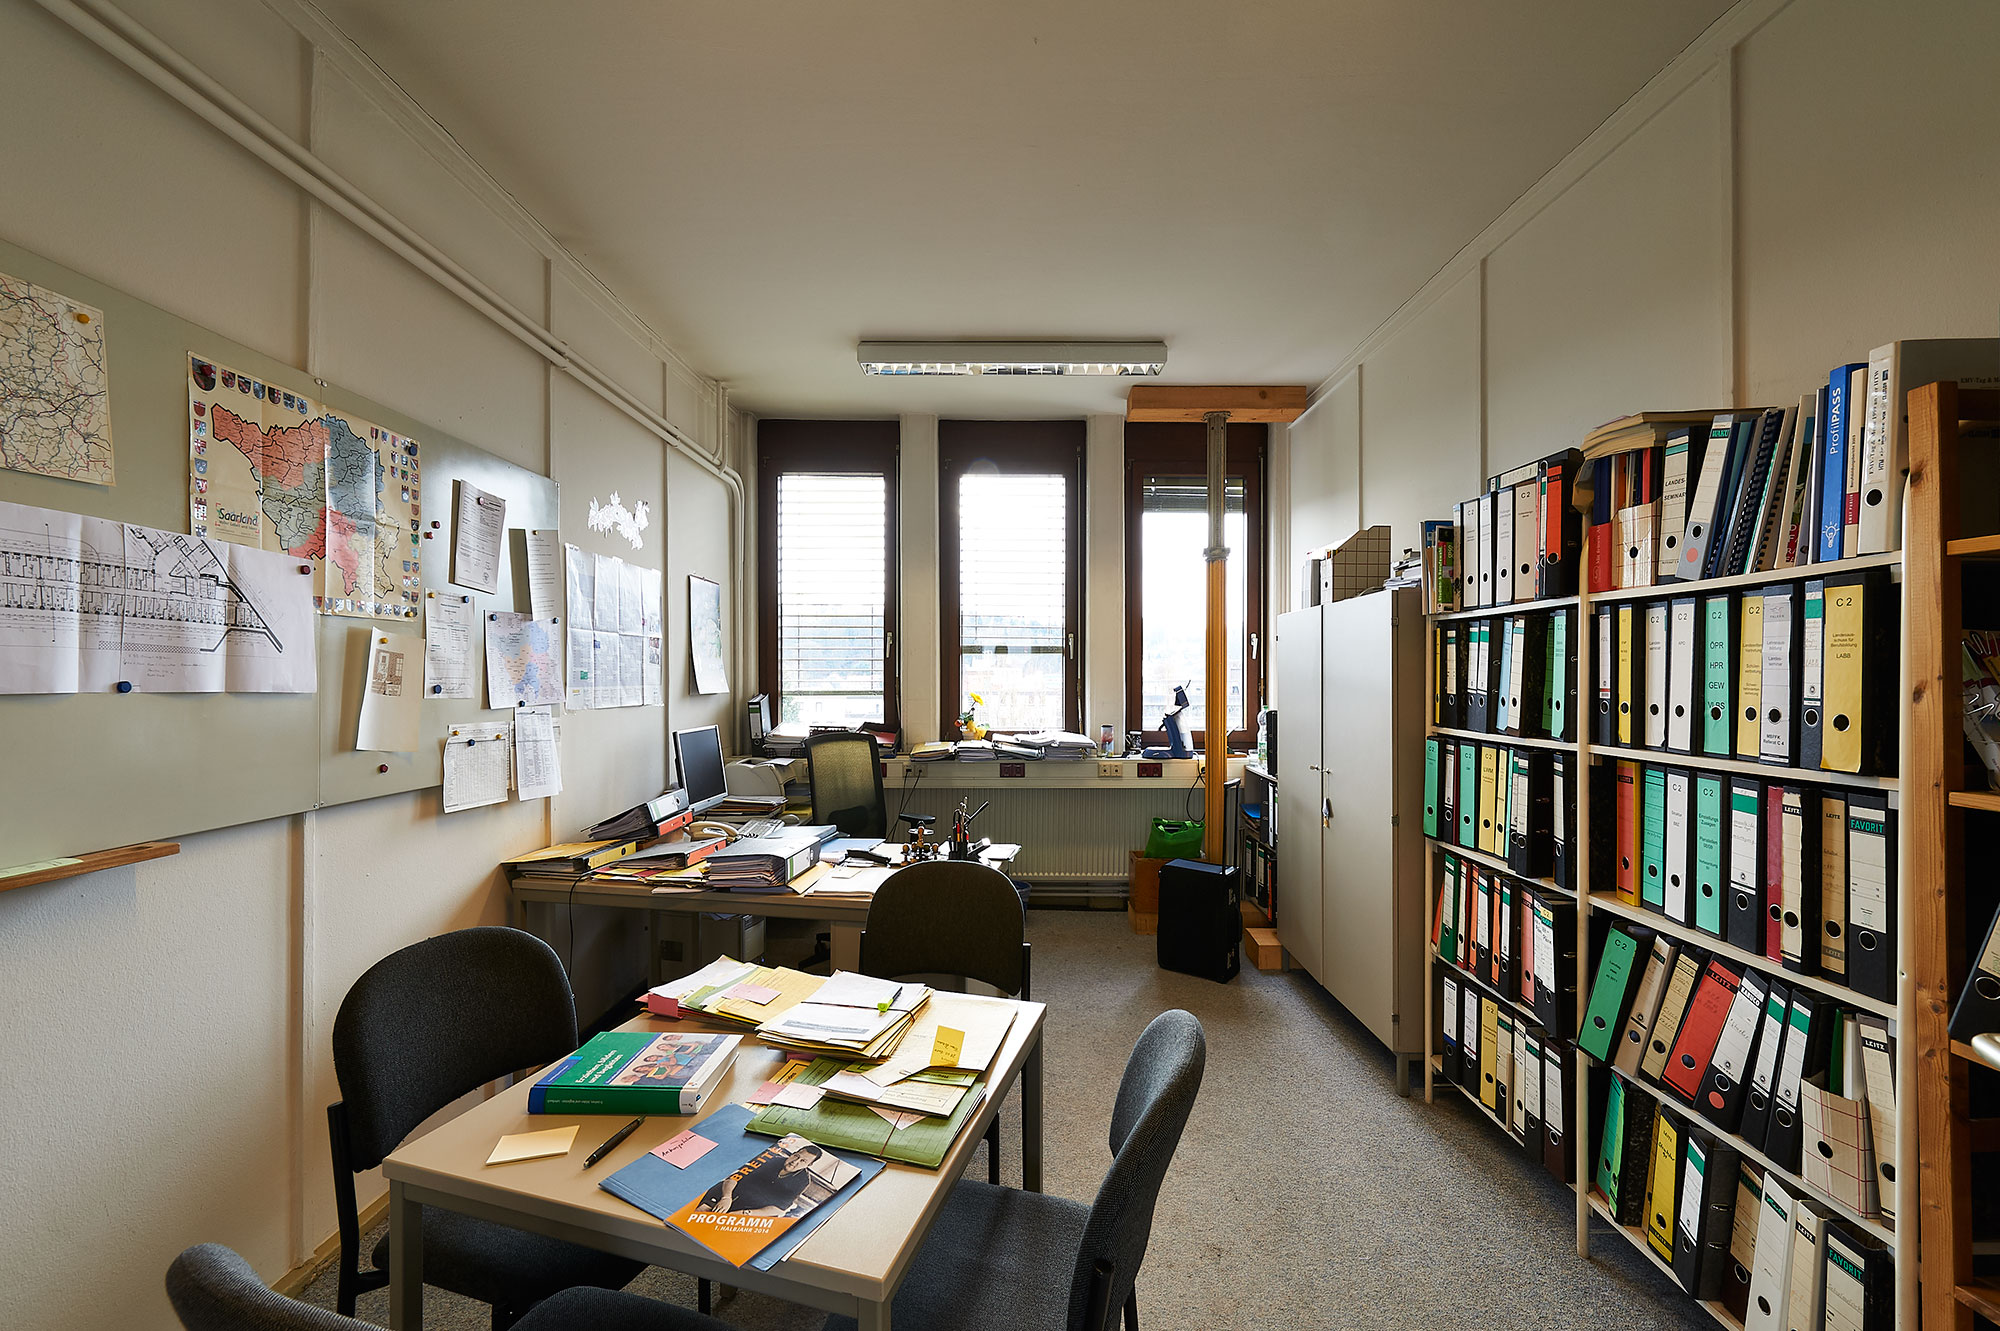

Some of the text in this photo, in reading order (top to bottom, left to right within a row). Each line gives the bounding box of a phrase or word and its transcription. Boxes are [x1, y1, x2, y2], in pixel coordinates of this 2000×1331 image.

[1830, 387, 1842, 455] ProfilPASS
[218, 508, 259, 527] Saarland
[1836, 598, 1852, 607] C 2
[1710, 661, 1724, 669] HPR
[1708, 682, 1725, 690] GEW
[1784, 806, 1800, 814] LEITZ
[1826, 812, 1840, 820] LEITZ
[1850, 819, 1884, 833] FAVORIT
[1710, 972, 1732, 990] LEITZ
[1865, 1040, 1885, 1050] LEITZ
[686, 1214, 774, 1228] PROGRAMM
[720, 1226, 753, 1234] HALBJAHR
[1798, 1225, 1813, 1241] LEITZ
[1828, 1249, 1862, 1280] FAVORIT
